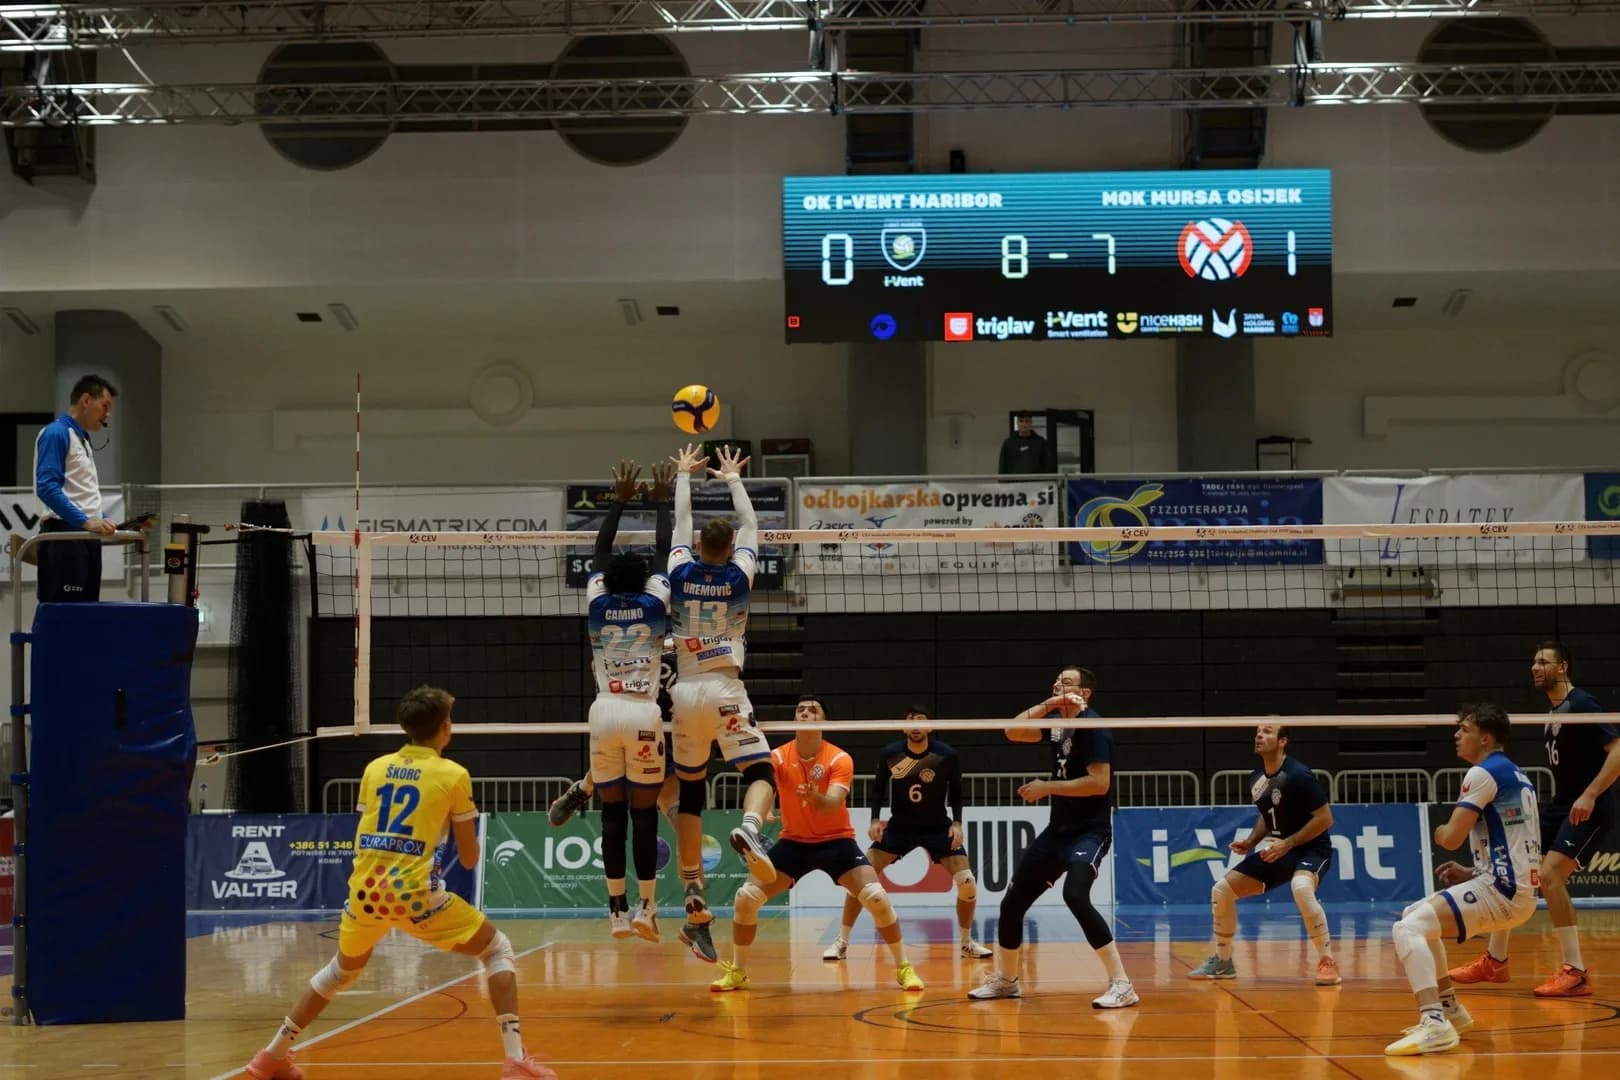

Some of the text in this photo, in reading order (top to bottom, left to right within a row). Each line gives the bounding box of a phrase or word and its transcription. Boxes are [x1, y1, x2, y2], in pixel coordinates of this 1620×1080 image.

[803, 193, 1003, 210] OK I-VENT MARIBOR
[1102, 188, 1303, 206] MOK MURSA OSIJEK
[822, 233, 853, 286] 0
[1001, 234, 1029, 279] 8
[1092, 233, 1116, 275] 7
[976, 316, 1035, 340] triglav
[1045, 310, 1108, 328] i-Vent
[803, 486, 1055, 514] odbojkarskaoprema.si
[1150, 505, 1249, 515] FIZIOTERAPIJA
[924, 517, 960, 527] powered
[962, 517, 973, 527] by
[420, 534, 437, 543] CEV
[775, 532, 792, 541] CEV
[1133, 529, 1149, 537] CEV
[605, 607, 644, 621] CAMINO
[684, 600, 728, 636] 13
[601, 623, 651, 653] 22
[1545, 739, 1560, 765] 16
[386, 764, 422, 780] ŠKORC
[908, 784, 923, 802] 6
[376, 782, 421, 836] 12
[1266, 807, 1278, 831] 1
[232, 826, 286, 838] RENT
[289, 841, 315, 850] +386
[359, 835, 424, 855] CURAPROX
[211, 879, 298, 899] VALTER
